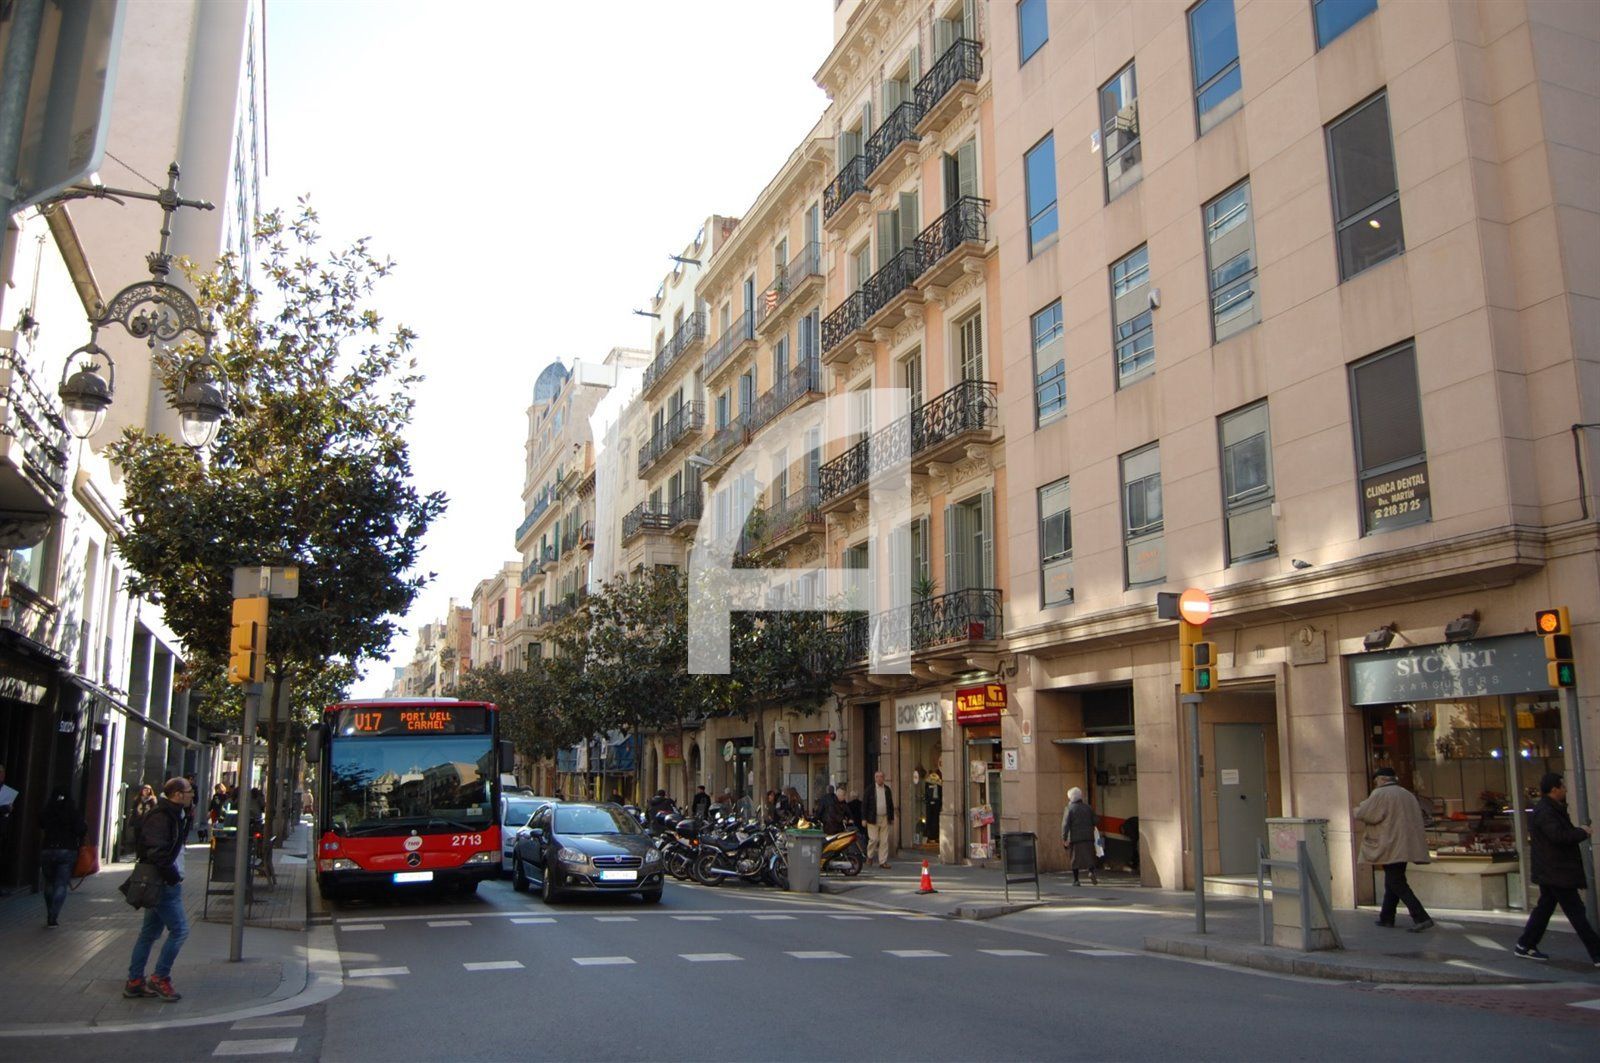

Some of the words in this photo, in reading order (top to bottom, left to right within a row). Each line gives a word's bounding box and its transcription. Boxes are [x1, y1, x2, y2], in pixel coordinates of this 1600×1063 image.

[1366, 481, 1396, 498] CLINICA
[1396, 473, 1425, 490] DENTAL
[1383, 505, 1397, 517] 218
[1399, 502, 1408, 513] 37
[1410, 499, 1421, 511] 25
[1396, 649, 1497, 677] SICART
[1399, 676, 1500, 693] XARCUERS
[354, 712, 382, 731] V17
[400, 713, 426, 721] PORT
[429, 712, 452, 721] VELL
[407, 720, 445, 730] CARMEL
[451, 834, 482, 847] 2713
